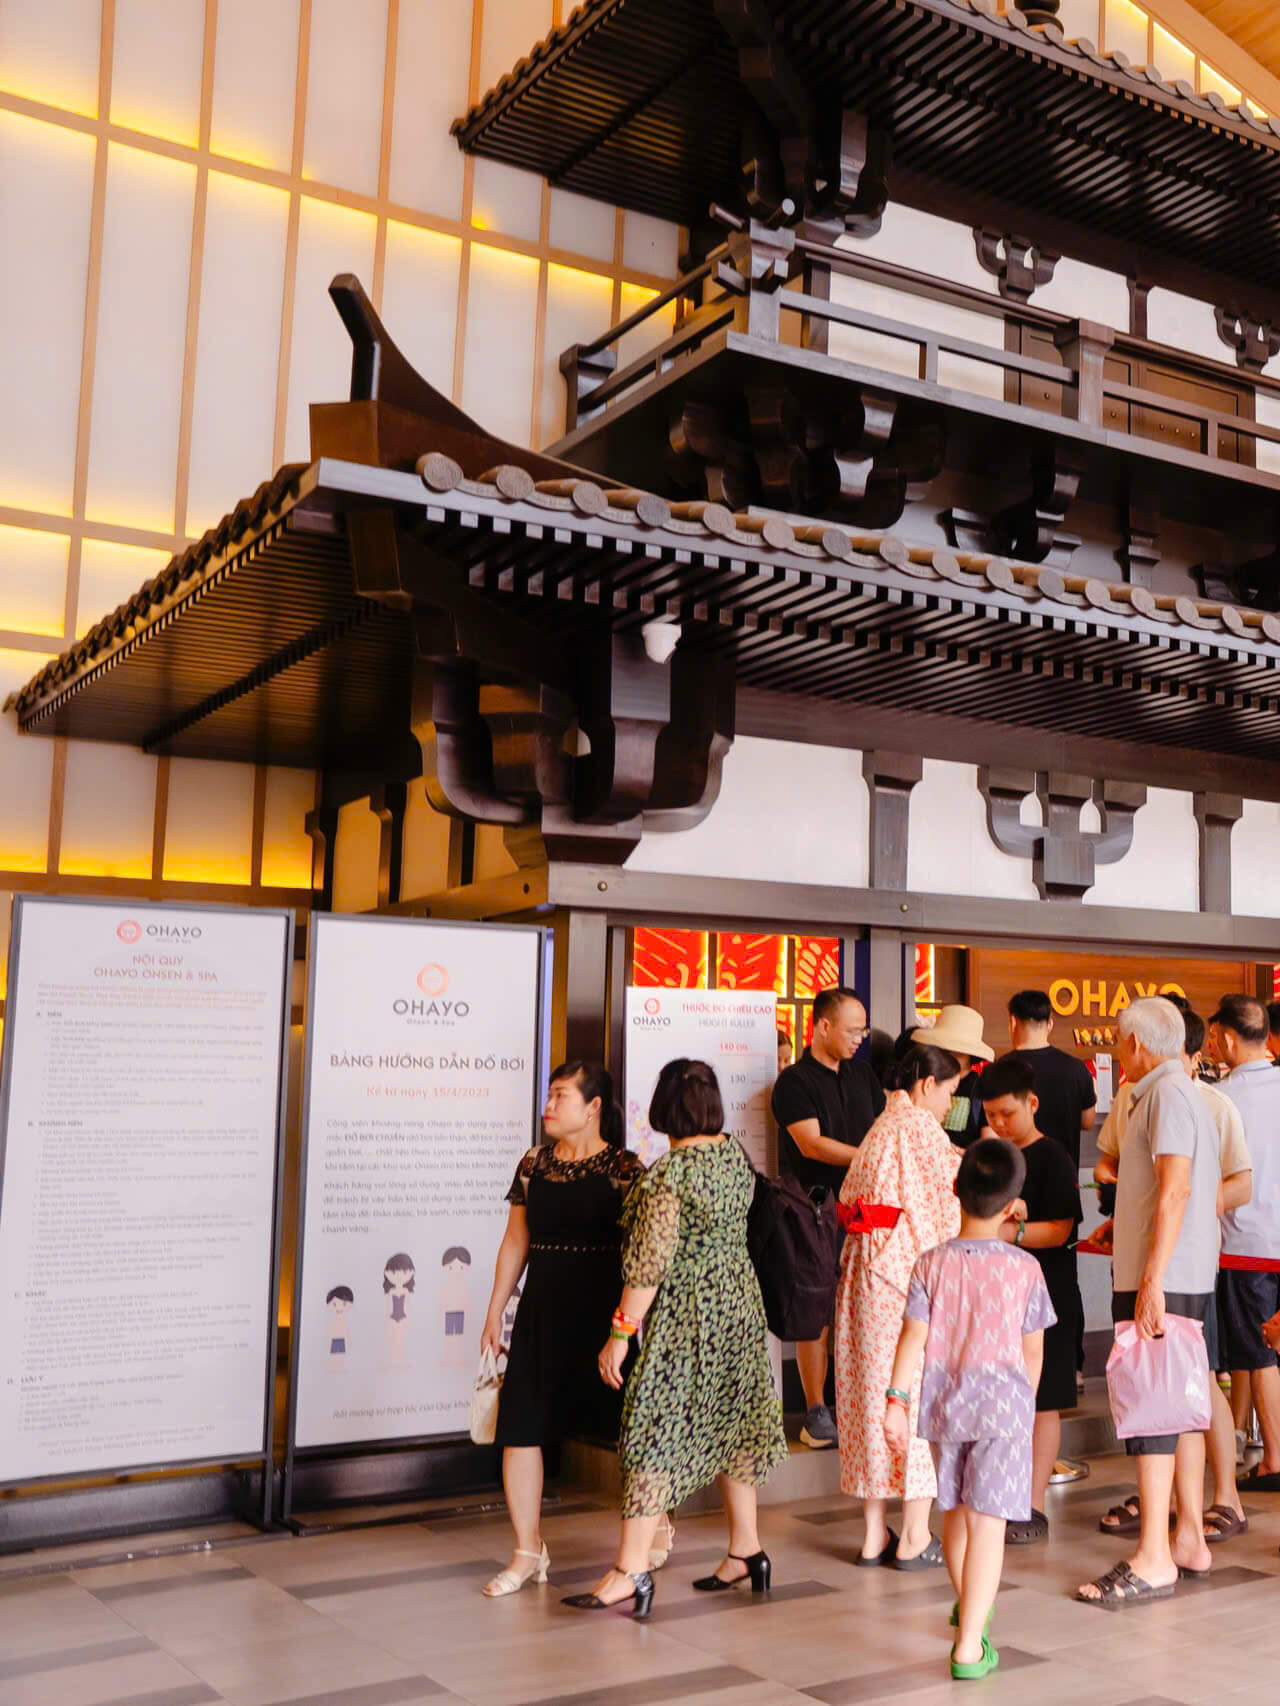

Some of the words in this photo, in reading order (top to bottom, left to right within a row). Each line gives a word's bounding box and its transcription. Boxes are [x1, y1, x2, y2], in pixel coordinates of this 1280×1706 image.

[146, 924, 202, 938] OHAYO
[93, 967, 138, 979] OHAYO
[142, 969, 182, 980] ONSEN
[392, 999, 470, 1017] OHAYO
[632, 1016, 671, 1026] OHAYO
